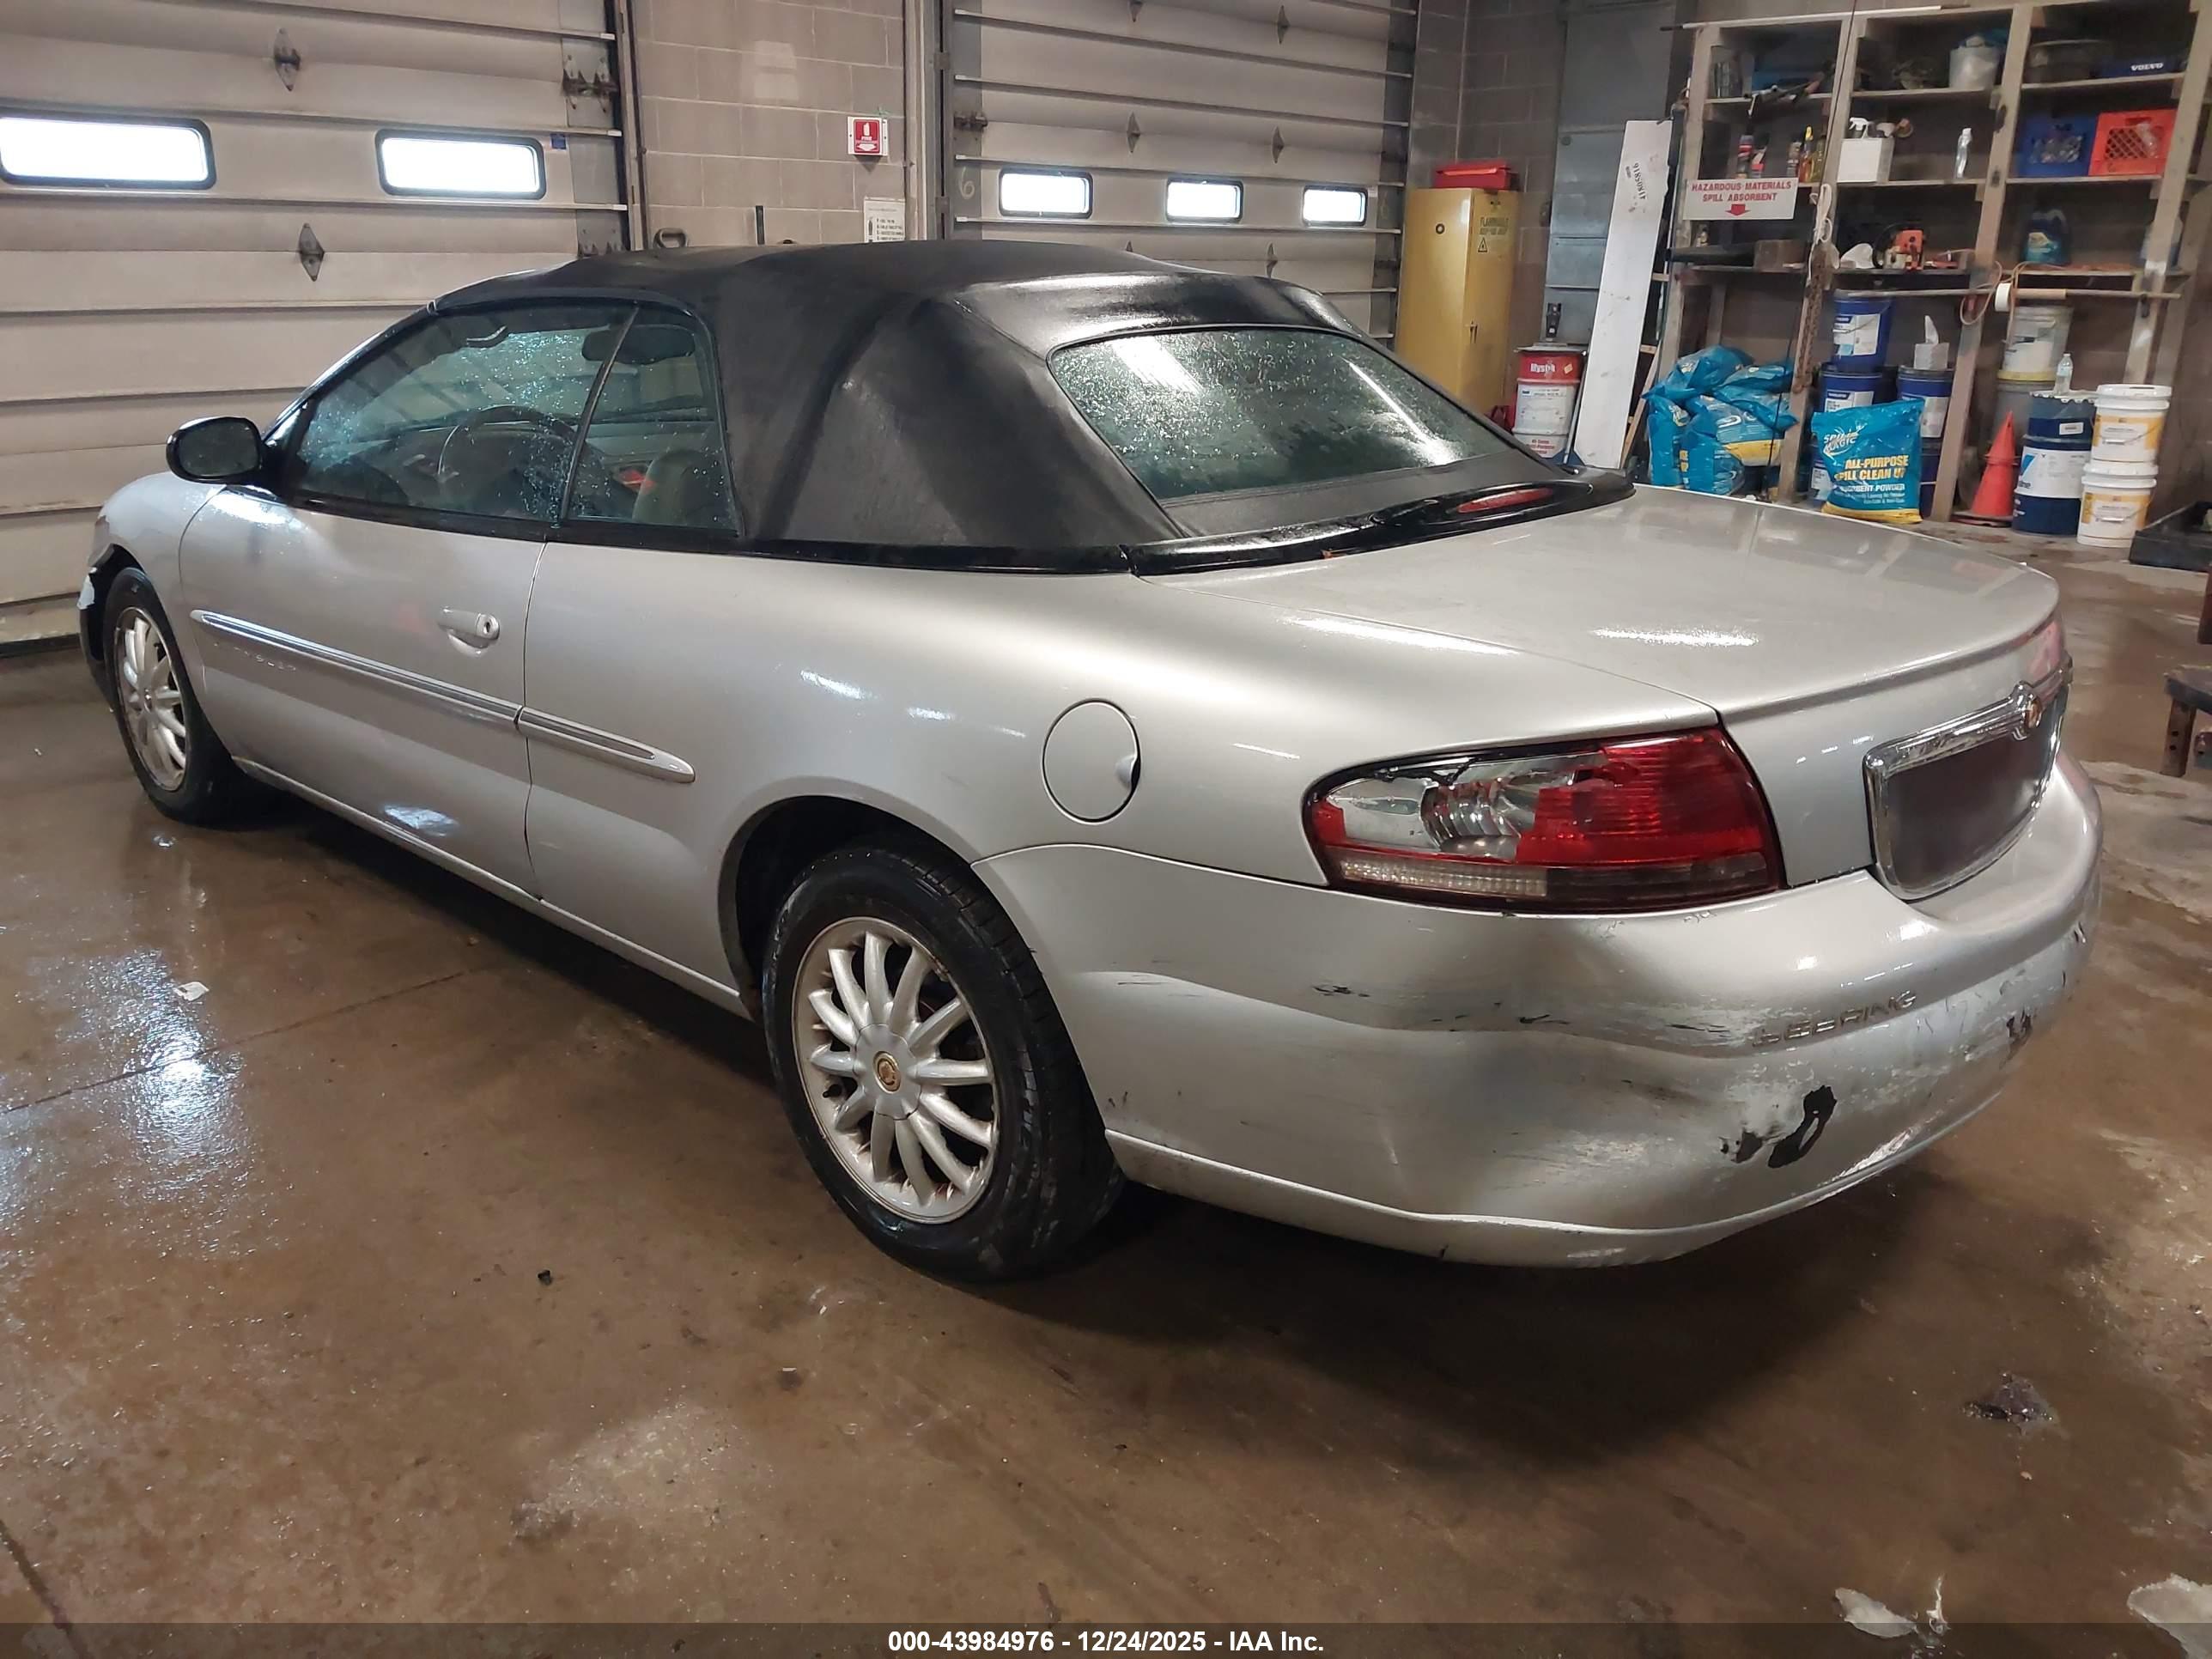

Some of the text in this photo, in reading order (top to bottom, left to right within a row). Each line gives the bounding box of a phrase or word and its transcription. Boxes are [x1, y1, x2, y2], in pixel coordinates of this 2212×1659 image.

[2130, 63, 2164, 71] VOLVO
[958, 166, 975, 199] 6
[1692, 181, 1791, 191] HAZARDOUS MATERIALS
[1703, 192, 1778, 203] SPILL ABSORBENT
[1845, 455, 1909, 470] ALL-PURPOSE
[1859, 468, 1891, 481] CLEAN
